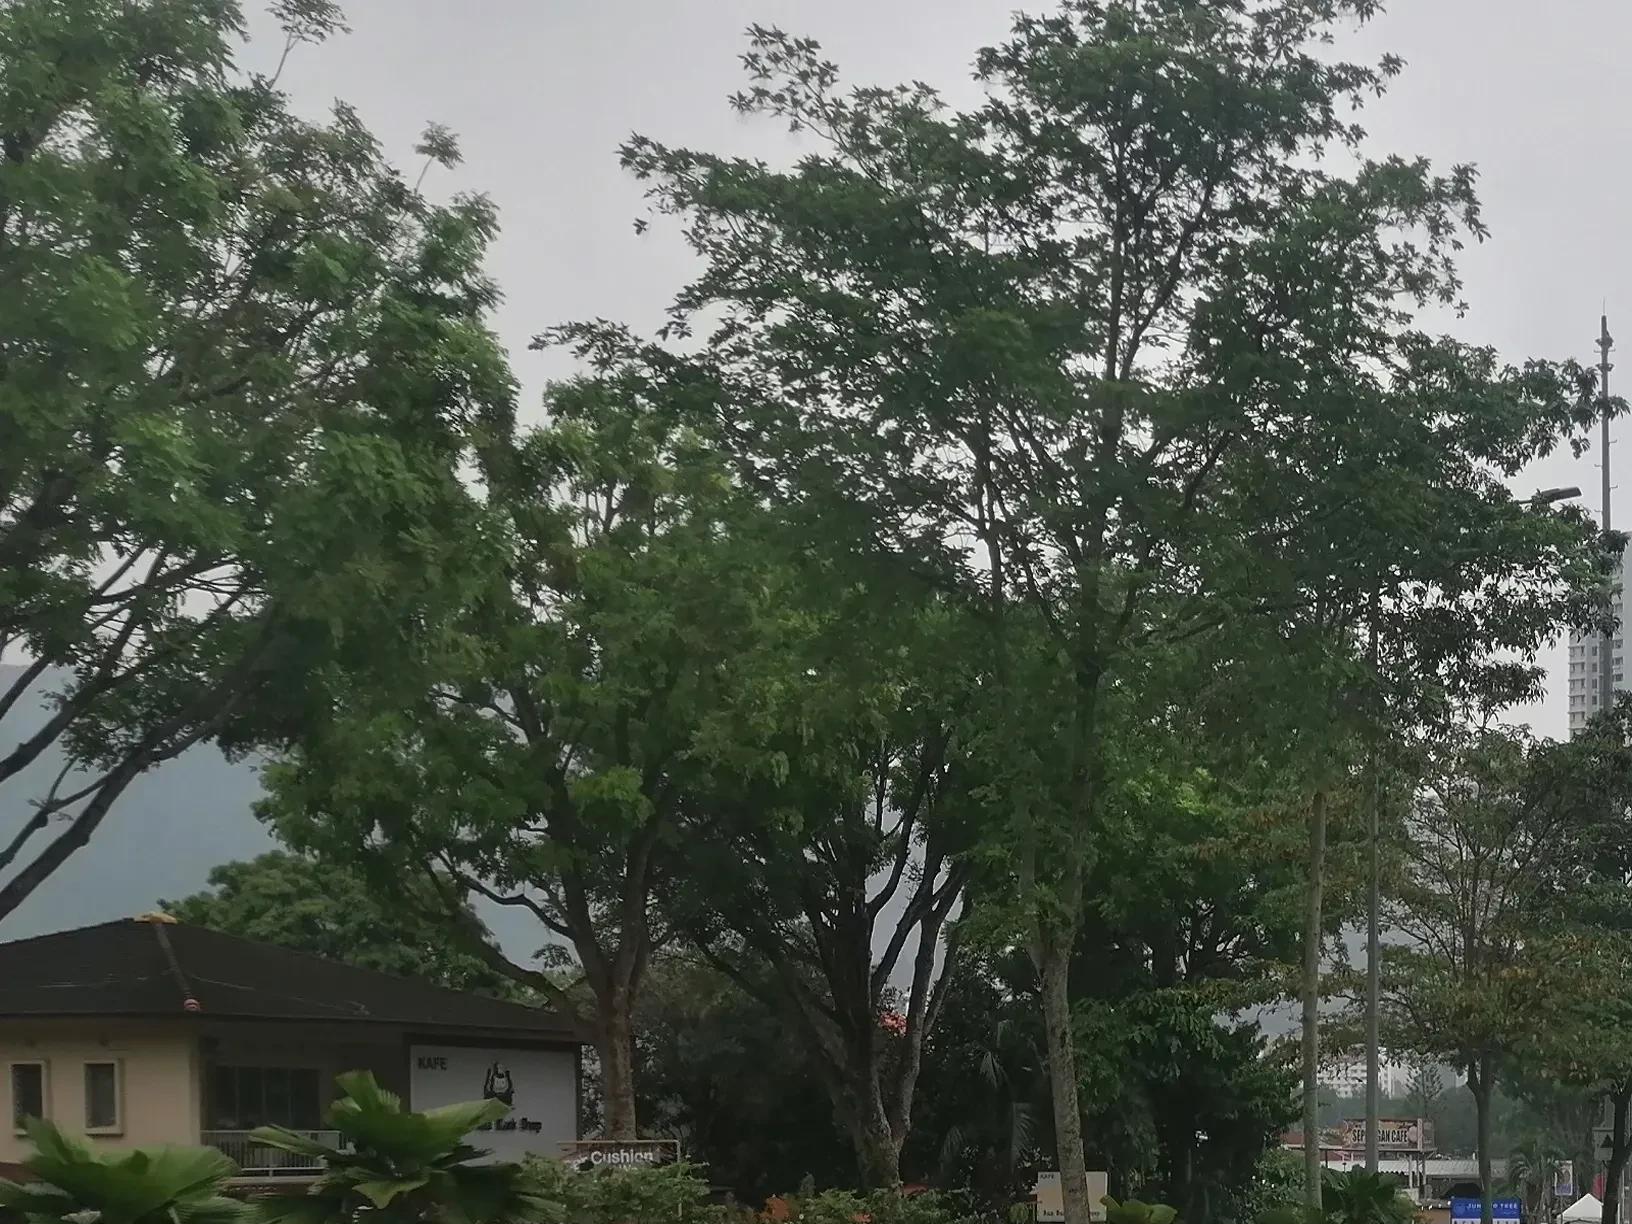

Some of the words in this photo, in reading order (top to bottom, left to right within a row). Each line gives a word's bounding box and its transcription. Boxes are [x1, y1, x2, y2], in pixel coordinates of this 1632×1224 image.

[417, 1056, 449, 1071] KAFE
[1391, 1128, 1408, 1143] CAFE
[590, 1148, 654, 1165] Cushion
